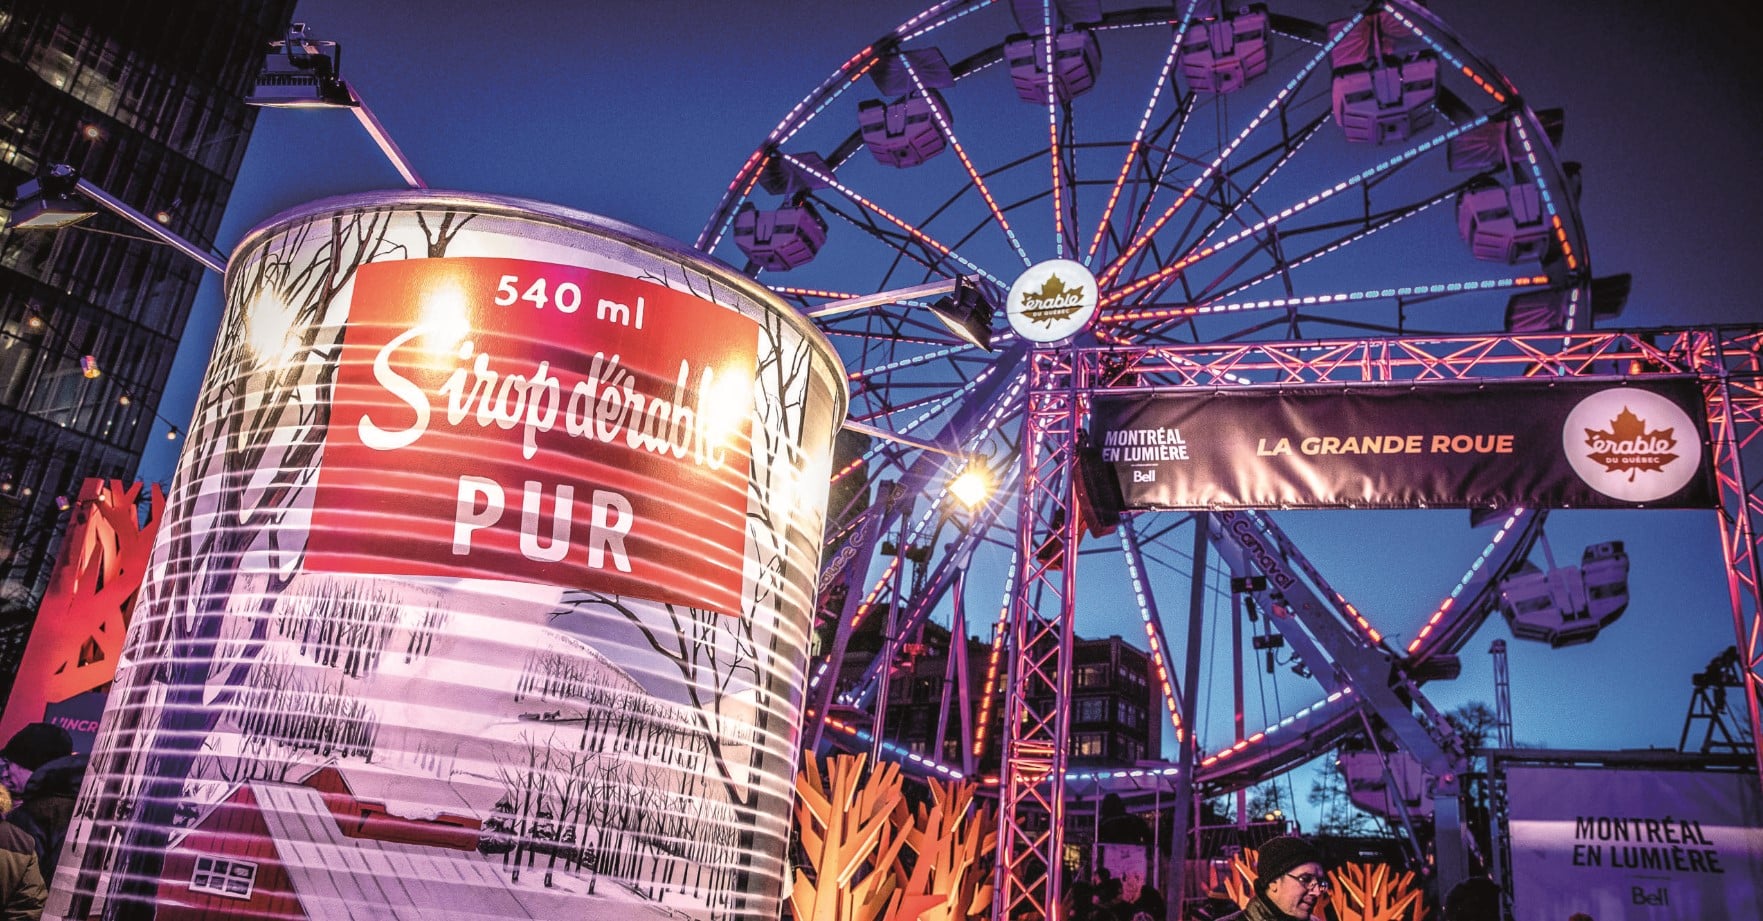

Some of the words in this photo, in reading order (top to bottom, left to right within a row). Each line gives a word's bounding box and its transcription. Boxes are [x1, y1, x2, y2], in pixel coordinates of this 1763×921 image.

[495, 275, 581, 314] 540
[597, 297, 645, 330] ml
[1026, 294, 1080, 309] érable
[357, 323, 560, 460] Sirop
[1104, 427, 1186, 447] MONTRÉAL
[1256, 438, 1293, 456] LA
[1300, 436, 1424, 455] GRANDE
[1430, 435, 1515, 453] ROUE
[1592, 435, 1671, 455] érable
[1102, 447, 1120, 462] EN
[1123, 445, 1190, 462] LUMIÈRE
[1622, 456, 1661, 464] QUÉBEC
[1133, 469, 1156, 483] Bell
[451, 475, 635, 573] PUR
[1575, 816, 1713, 845] MONTRÉAL
[1572, 845, 1602, 867] EN
[1611, 845, 1725, 873] LUMIÈRE
[1632, 886, 1668, 905] Bell
